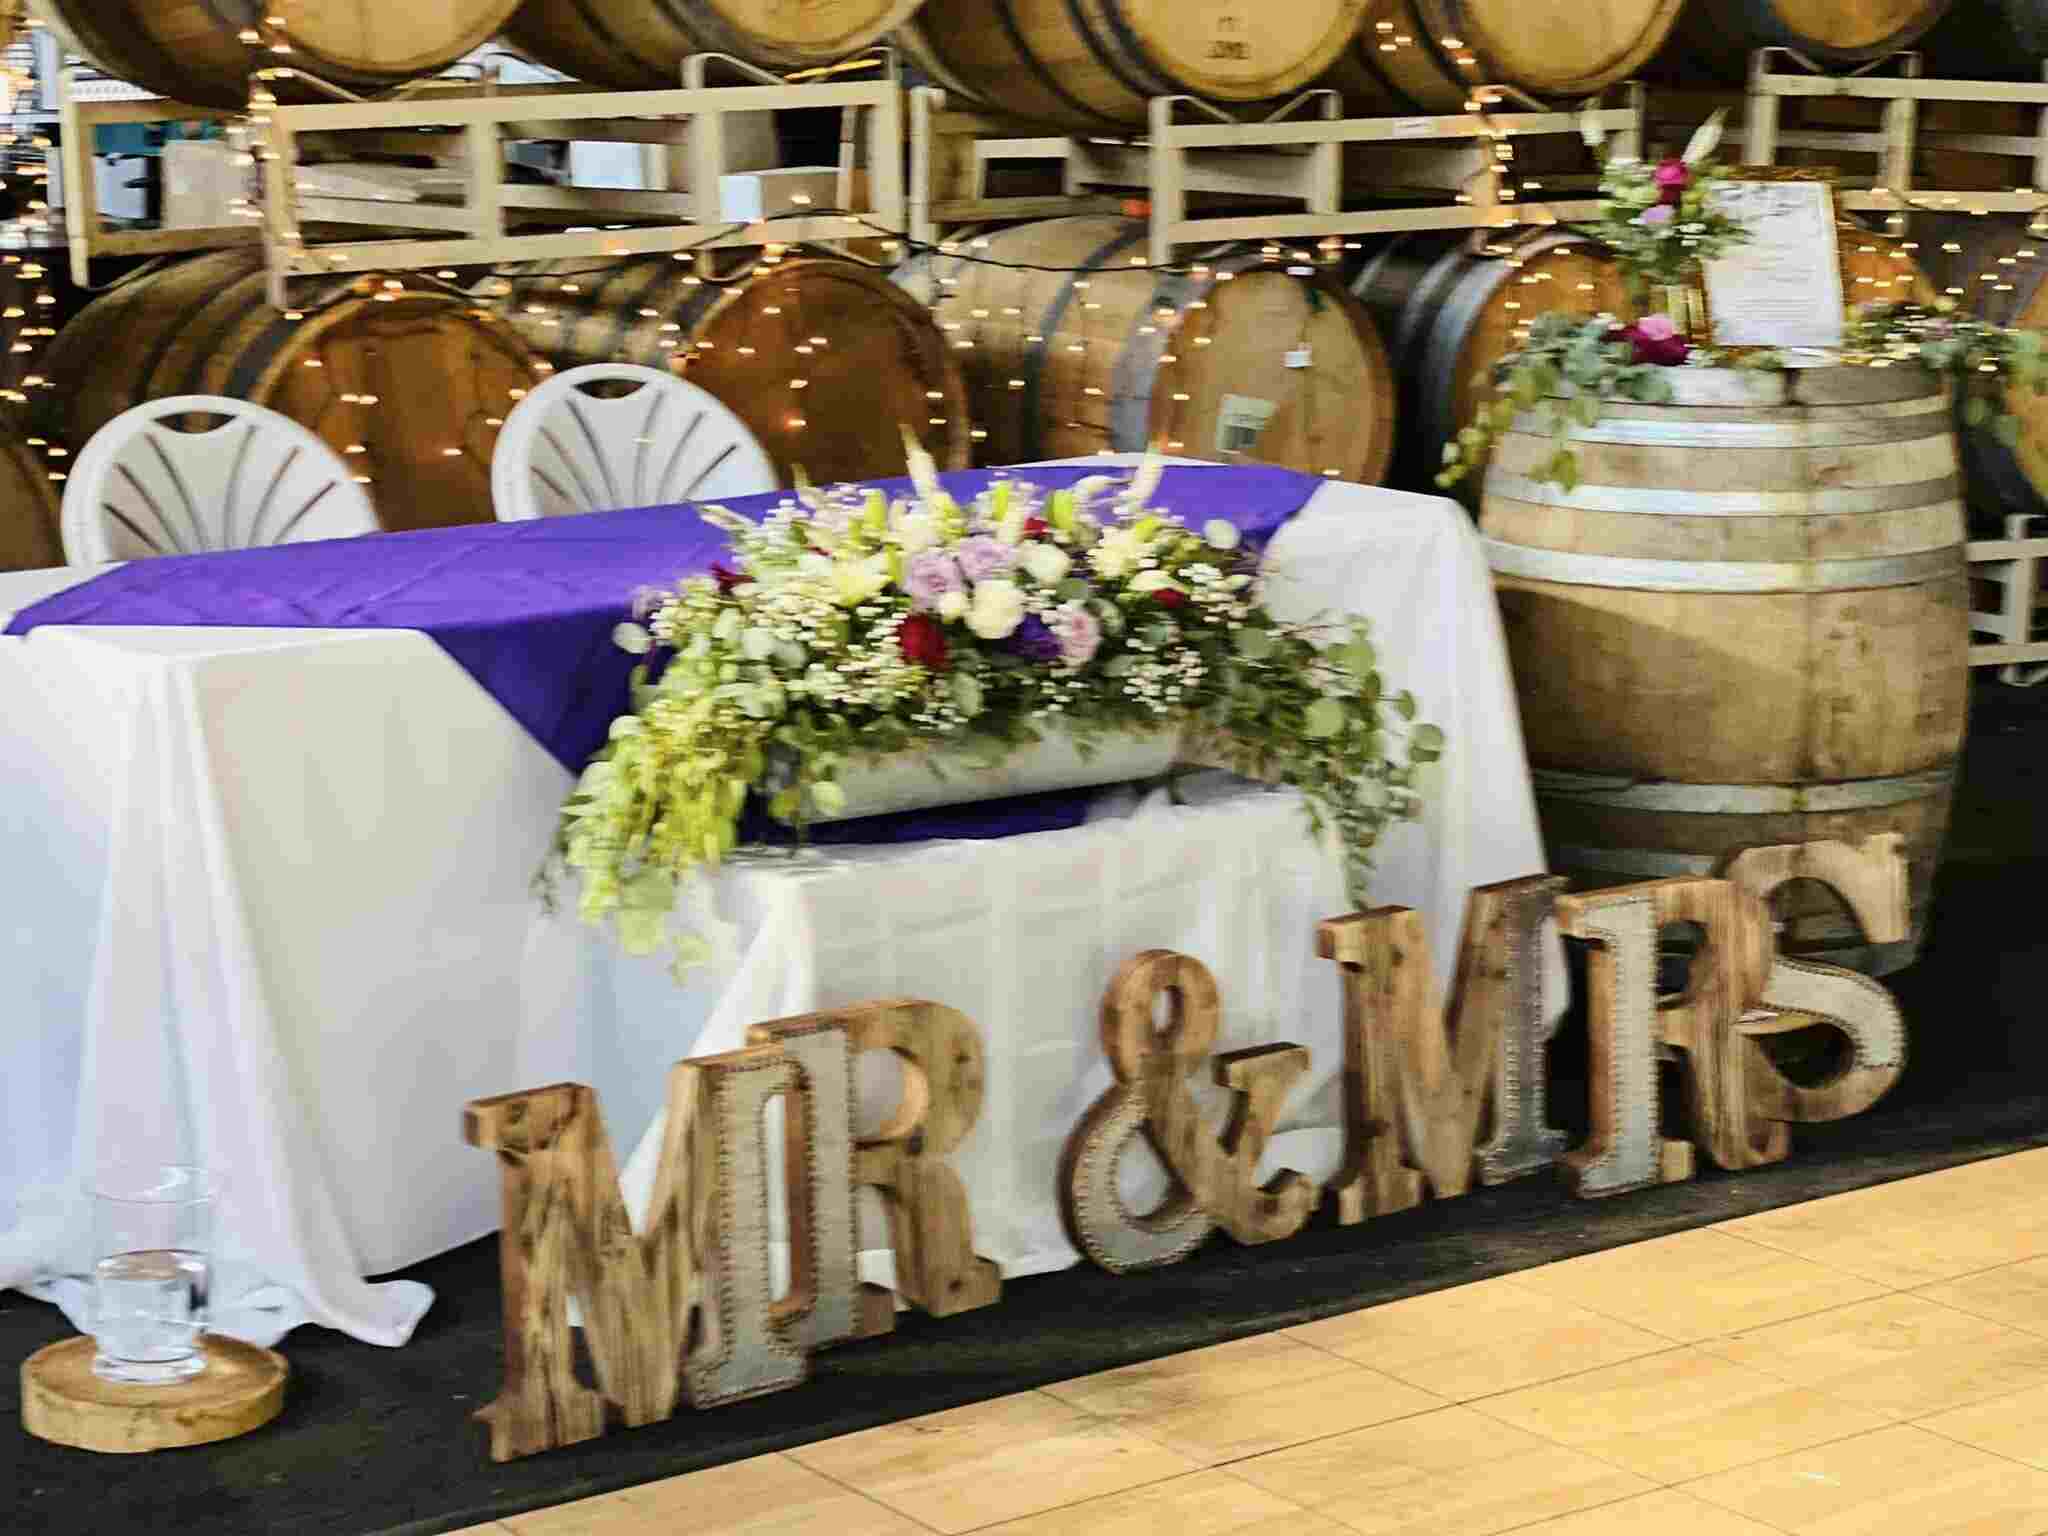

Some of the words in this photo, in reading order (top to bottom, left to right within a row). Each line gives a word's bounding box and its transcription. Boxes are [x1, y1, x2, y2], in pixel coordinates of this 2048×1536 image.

[463, 998, 1003, 1463] MR
[1060, 948, 1319, 1274] &
[1315, 831, 1908, 1225] MRS
